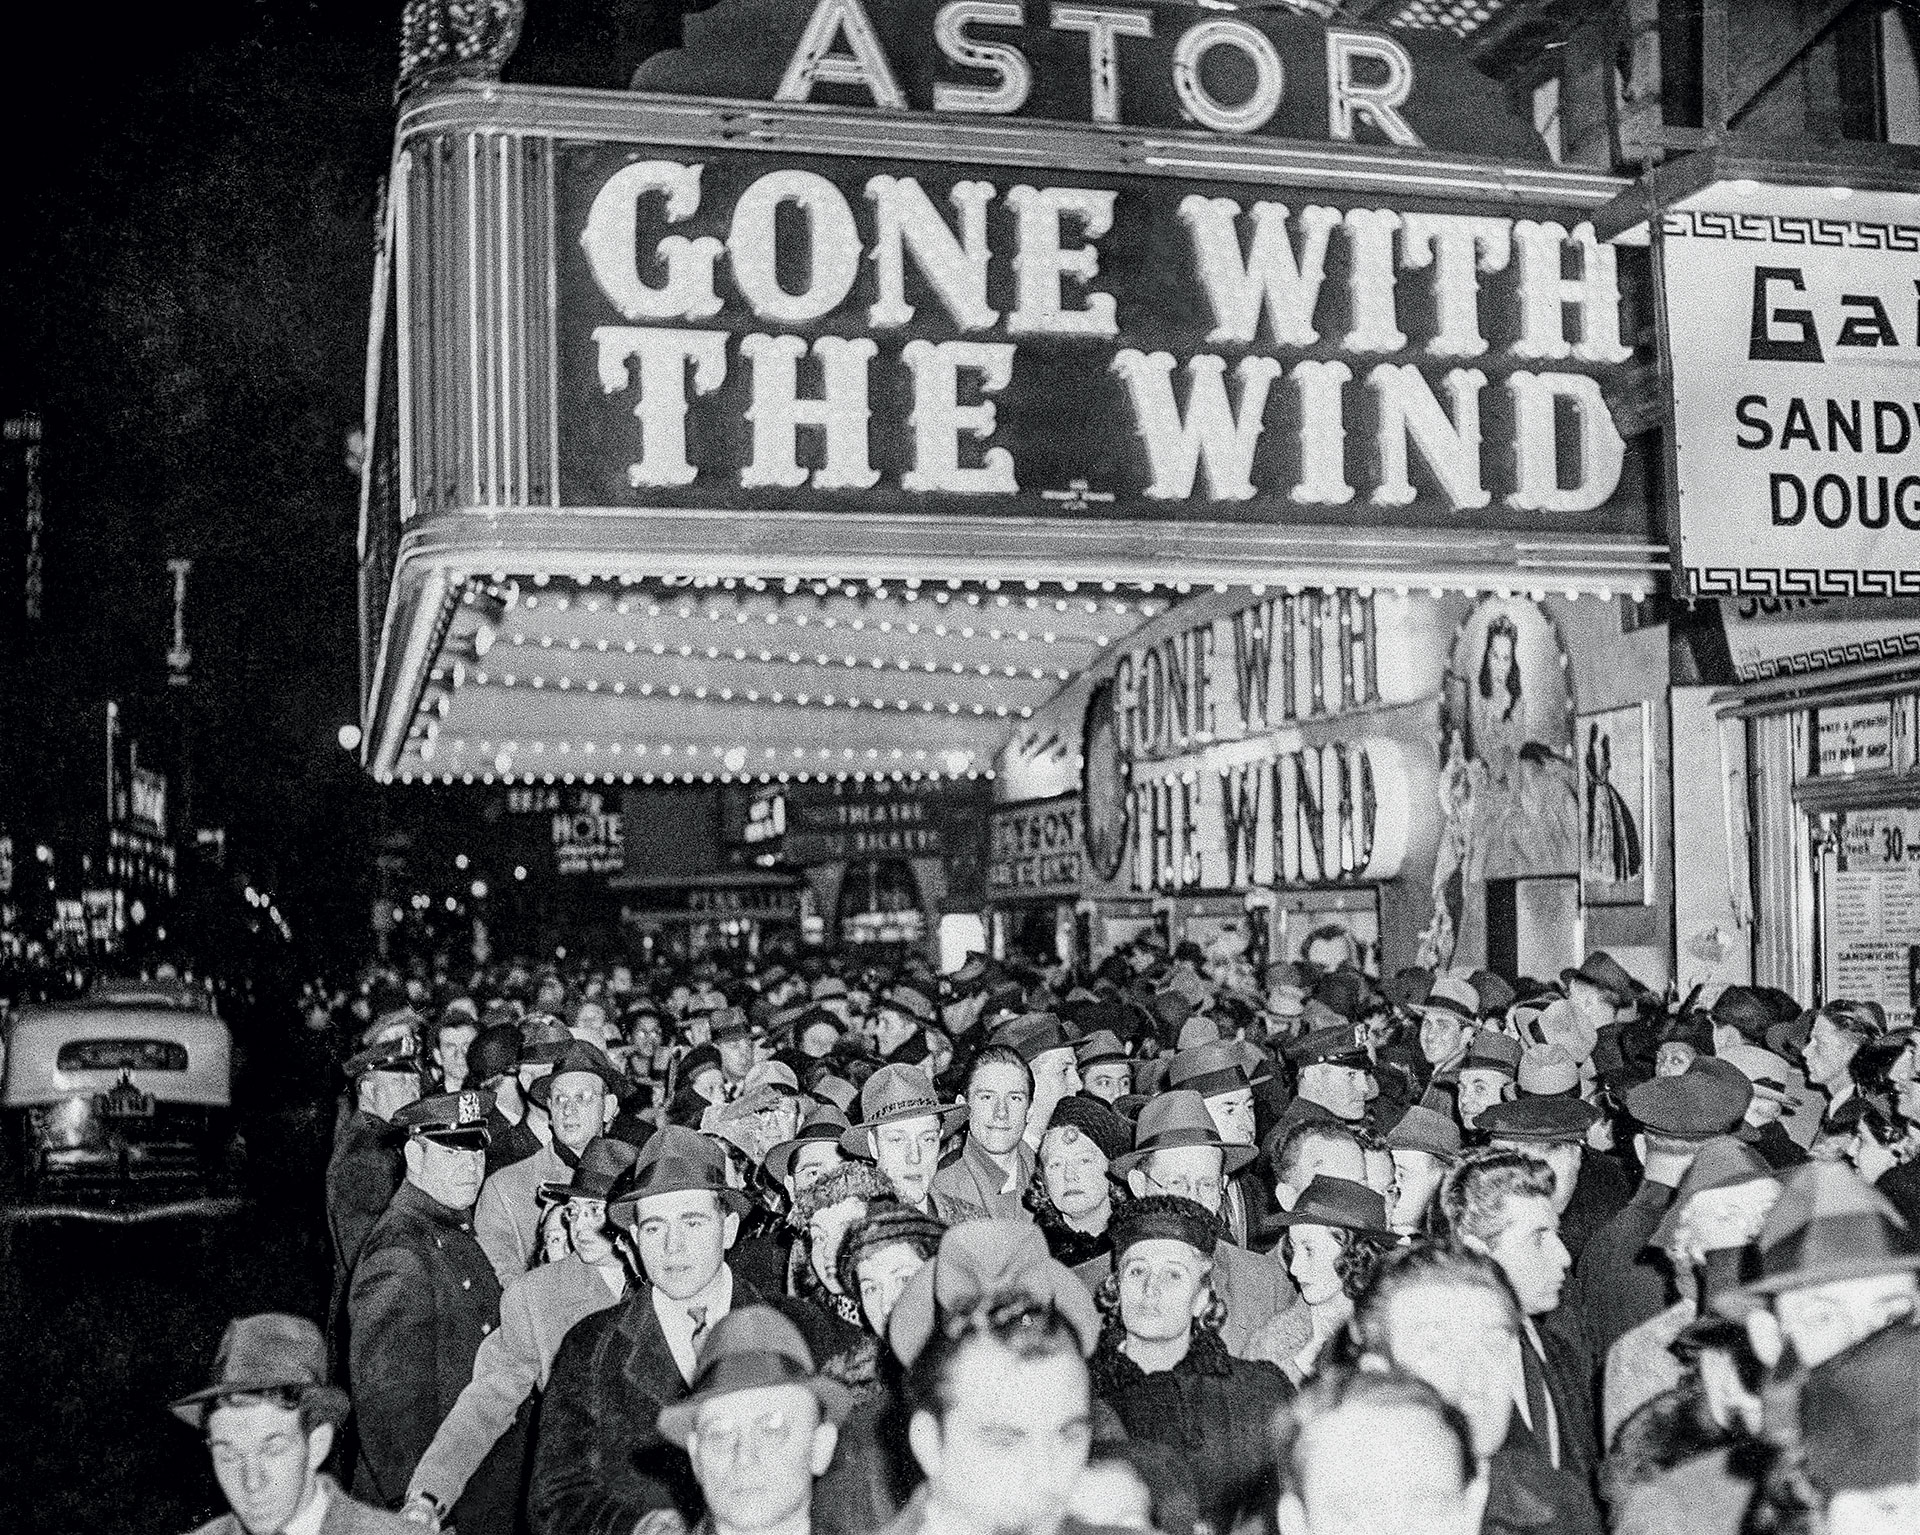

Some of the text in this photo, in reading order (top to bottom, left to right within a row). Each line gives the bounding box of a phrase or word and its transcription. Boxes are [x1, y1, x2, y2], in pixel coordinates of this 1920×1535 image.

[774, 0, 1425, 147] ASTOR
[580, 160, 1634, 363] GONE WITH
[1748, 265, 1920, 363] Ga
[590, 326, 1627, 512] THE WIND
[1735, 395, 1920, 453] SAND
[1113, 588, 1382, 755] GONE WITH
[1128, 742, 1377, 892] THE WIND
[1882, 825, 1904, 864] 30
